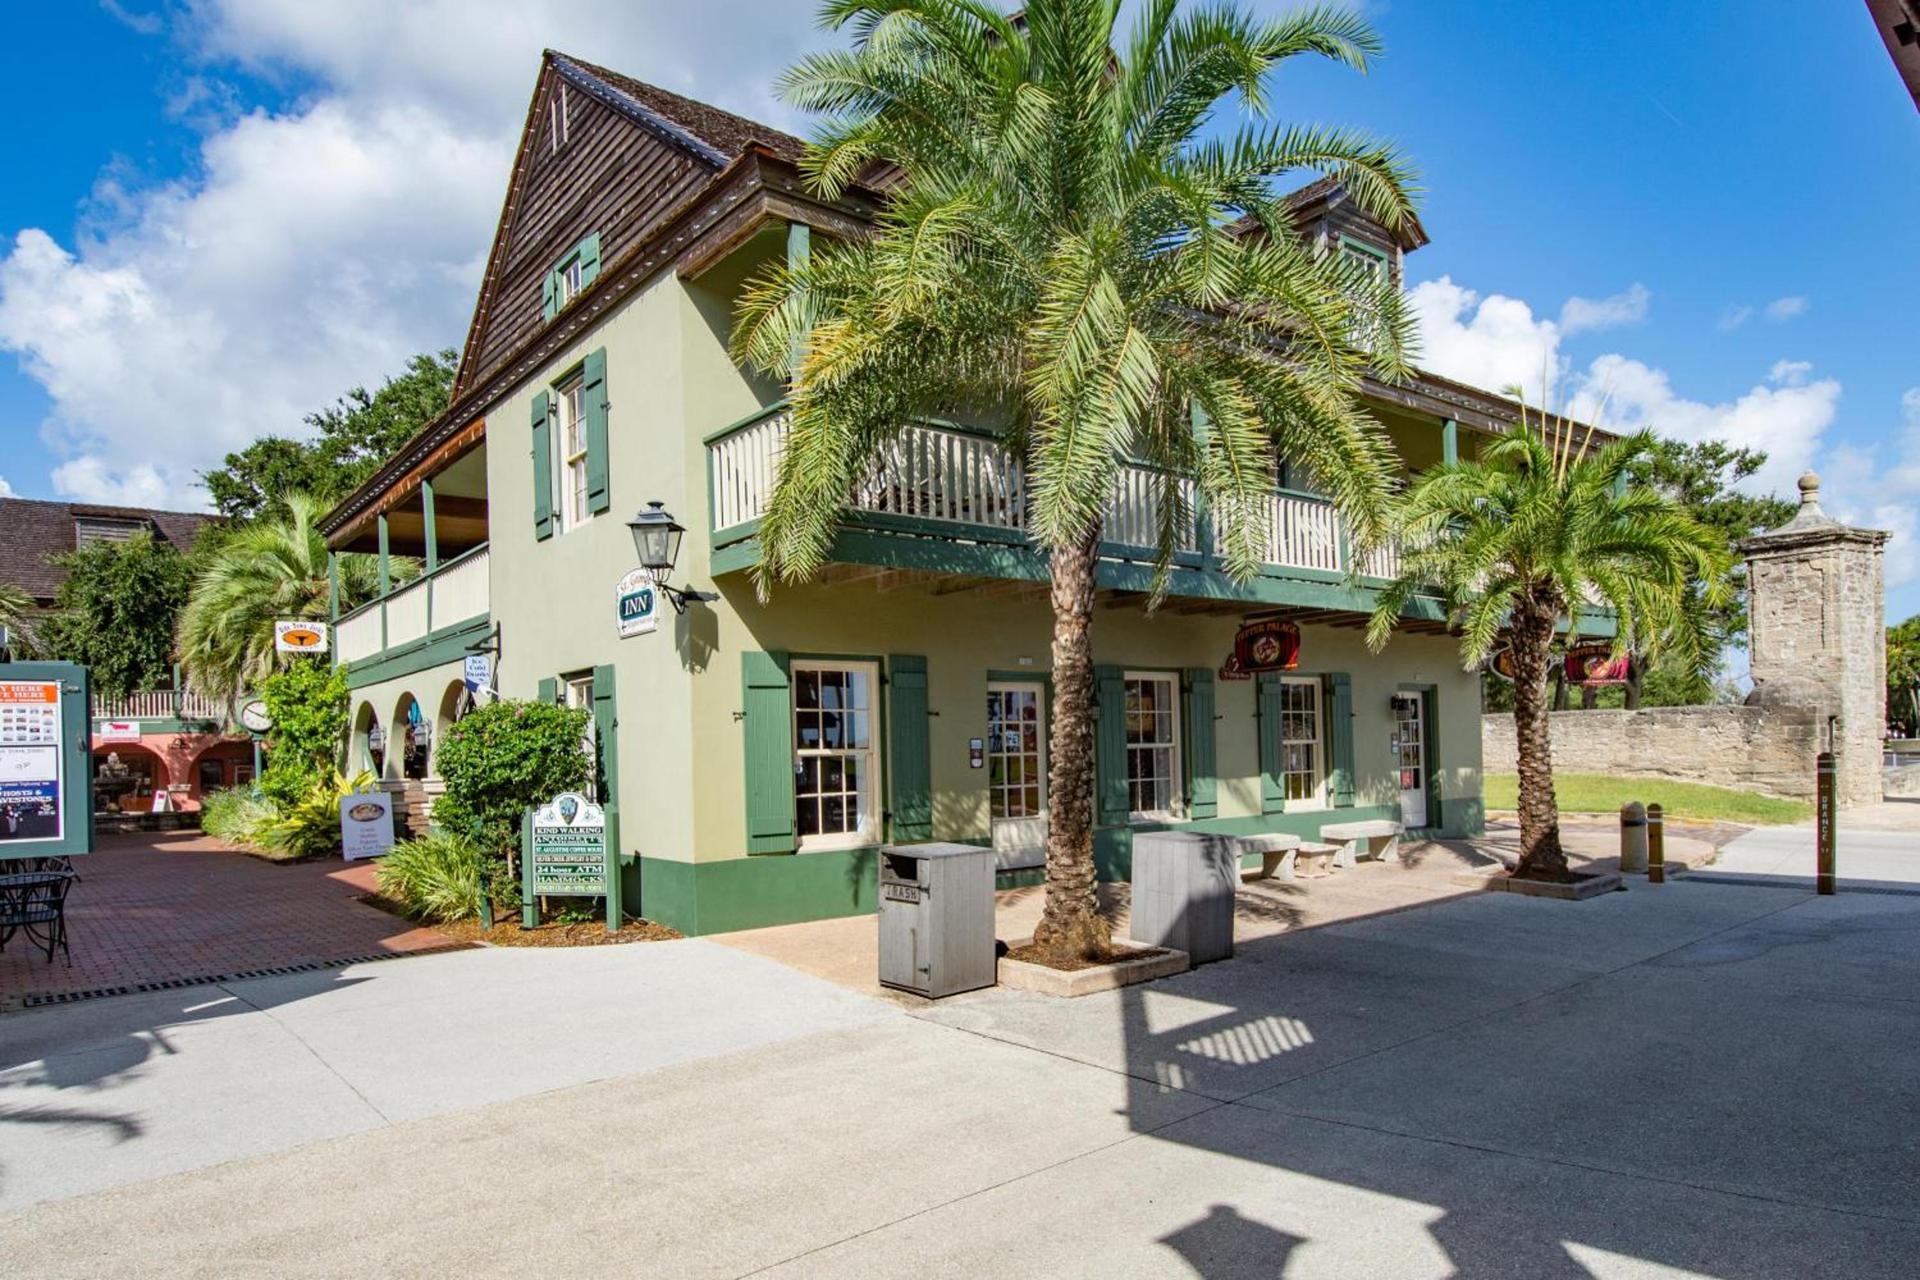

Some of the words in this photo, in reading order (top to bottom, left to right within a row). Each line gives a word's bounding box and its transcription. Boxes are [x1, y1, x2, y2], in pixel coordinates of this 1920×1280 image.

[624, 594, 648, 616] INN
[1821, 795, 1829, 841] ORANGE
[886, 885, 918, 900] TRASH
